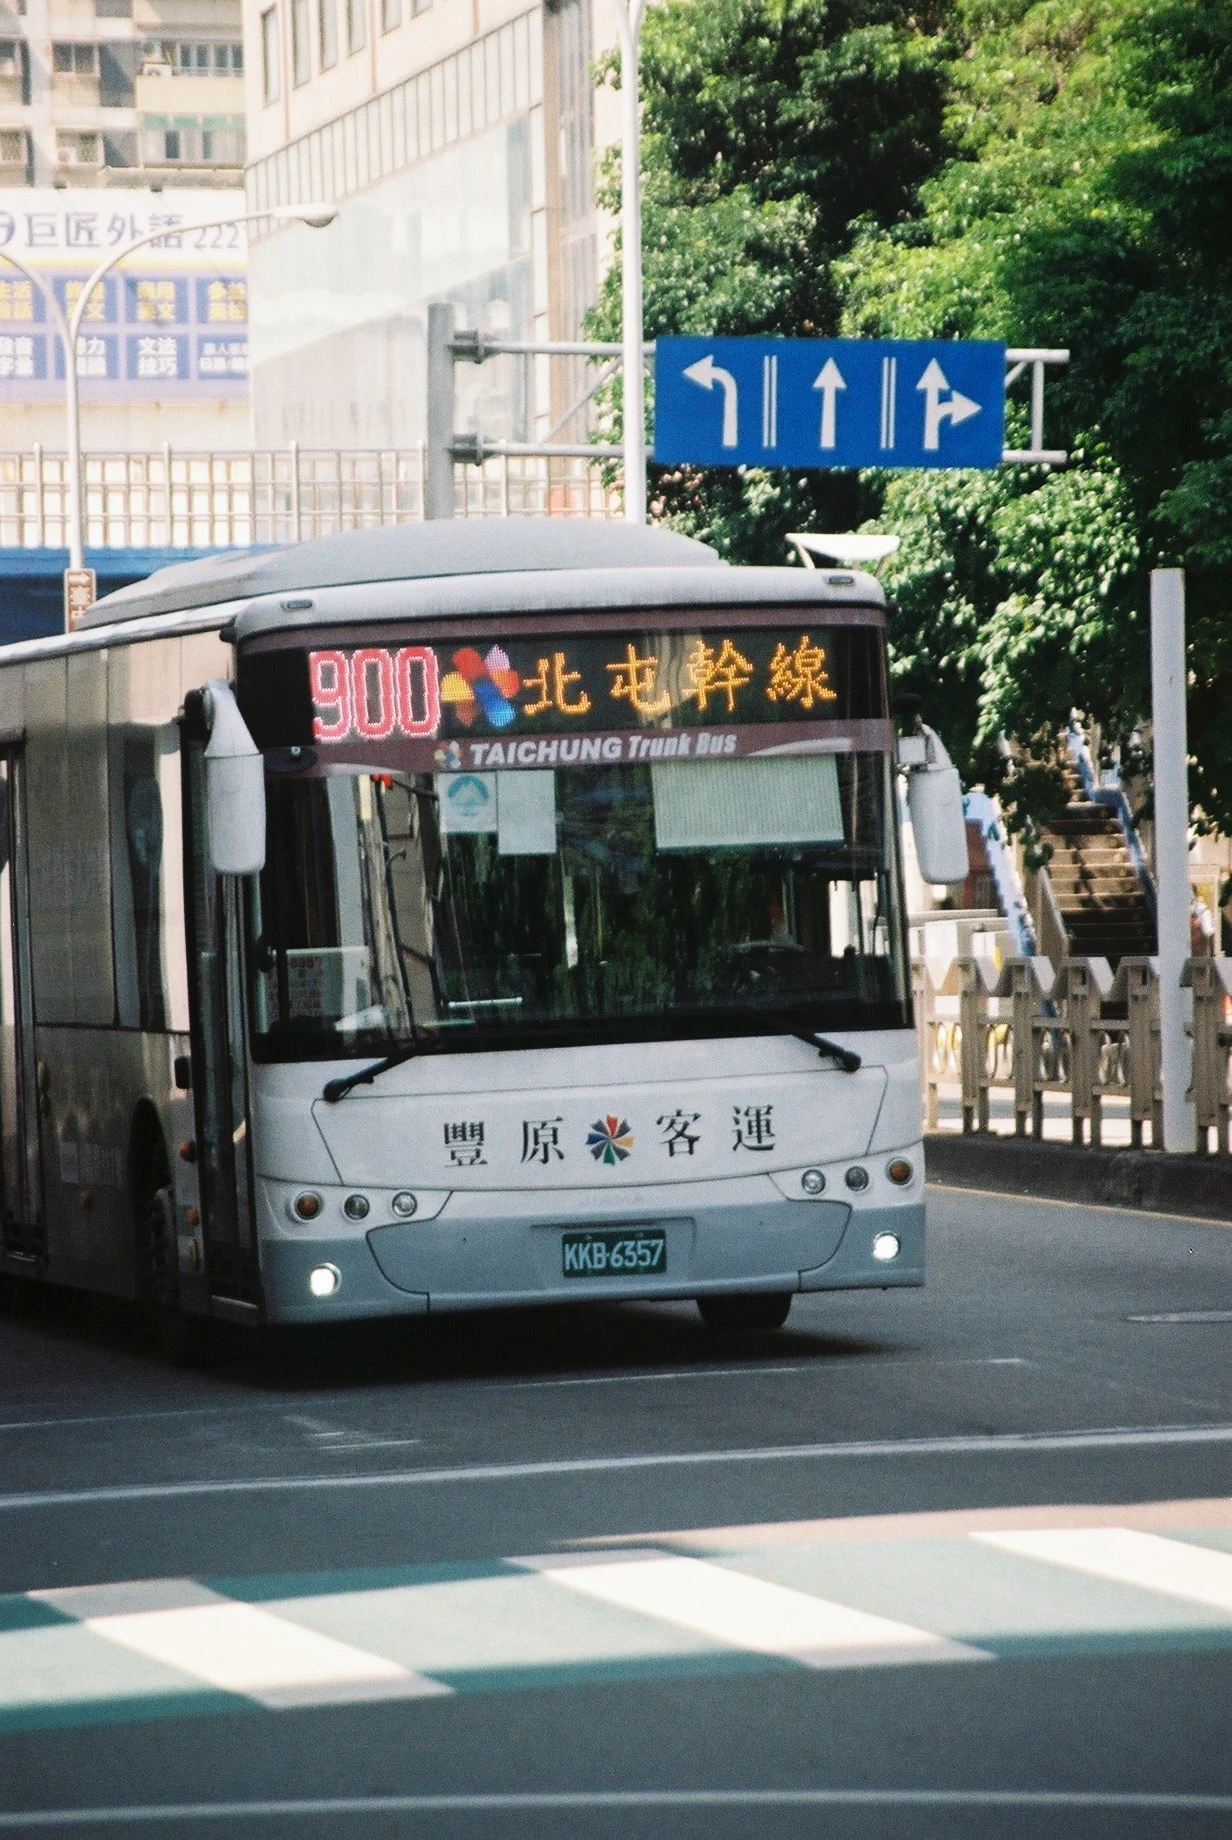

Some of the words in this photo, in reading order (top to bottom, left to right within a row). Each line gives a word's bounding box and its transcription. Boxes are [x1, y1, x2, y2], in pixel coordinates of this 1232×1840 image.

[23, 211, 184, 249] 巨匠外語
[309, 645, 442, 744] 900
[521, 634, 838, 716] 北屯幹線
[469, 736, 623, 766] TAICHUNG
[627, 732, 691, 759] Trunk
[695, 731, 738, 755] Bus
[442, 1115, 566, 1168] 豐原
[655, 1103, 777, 1158] 客運
[564, 1238, 665, 1271] KKB-6357
